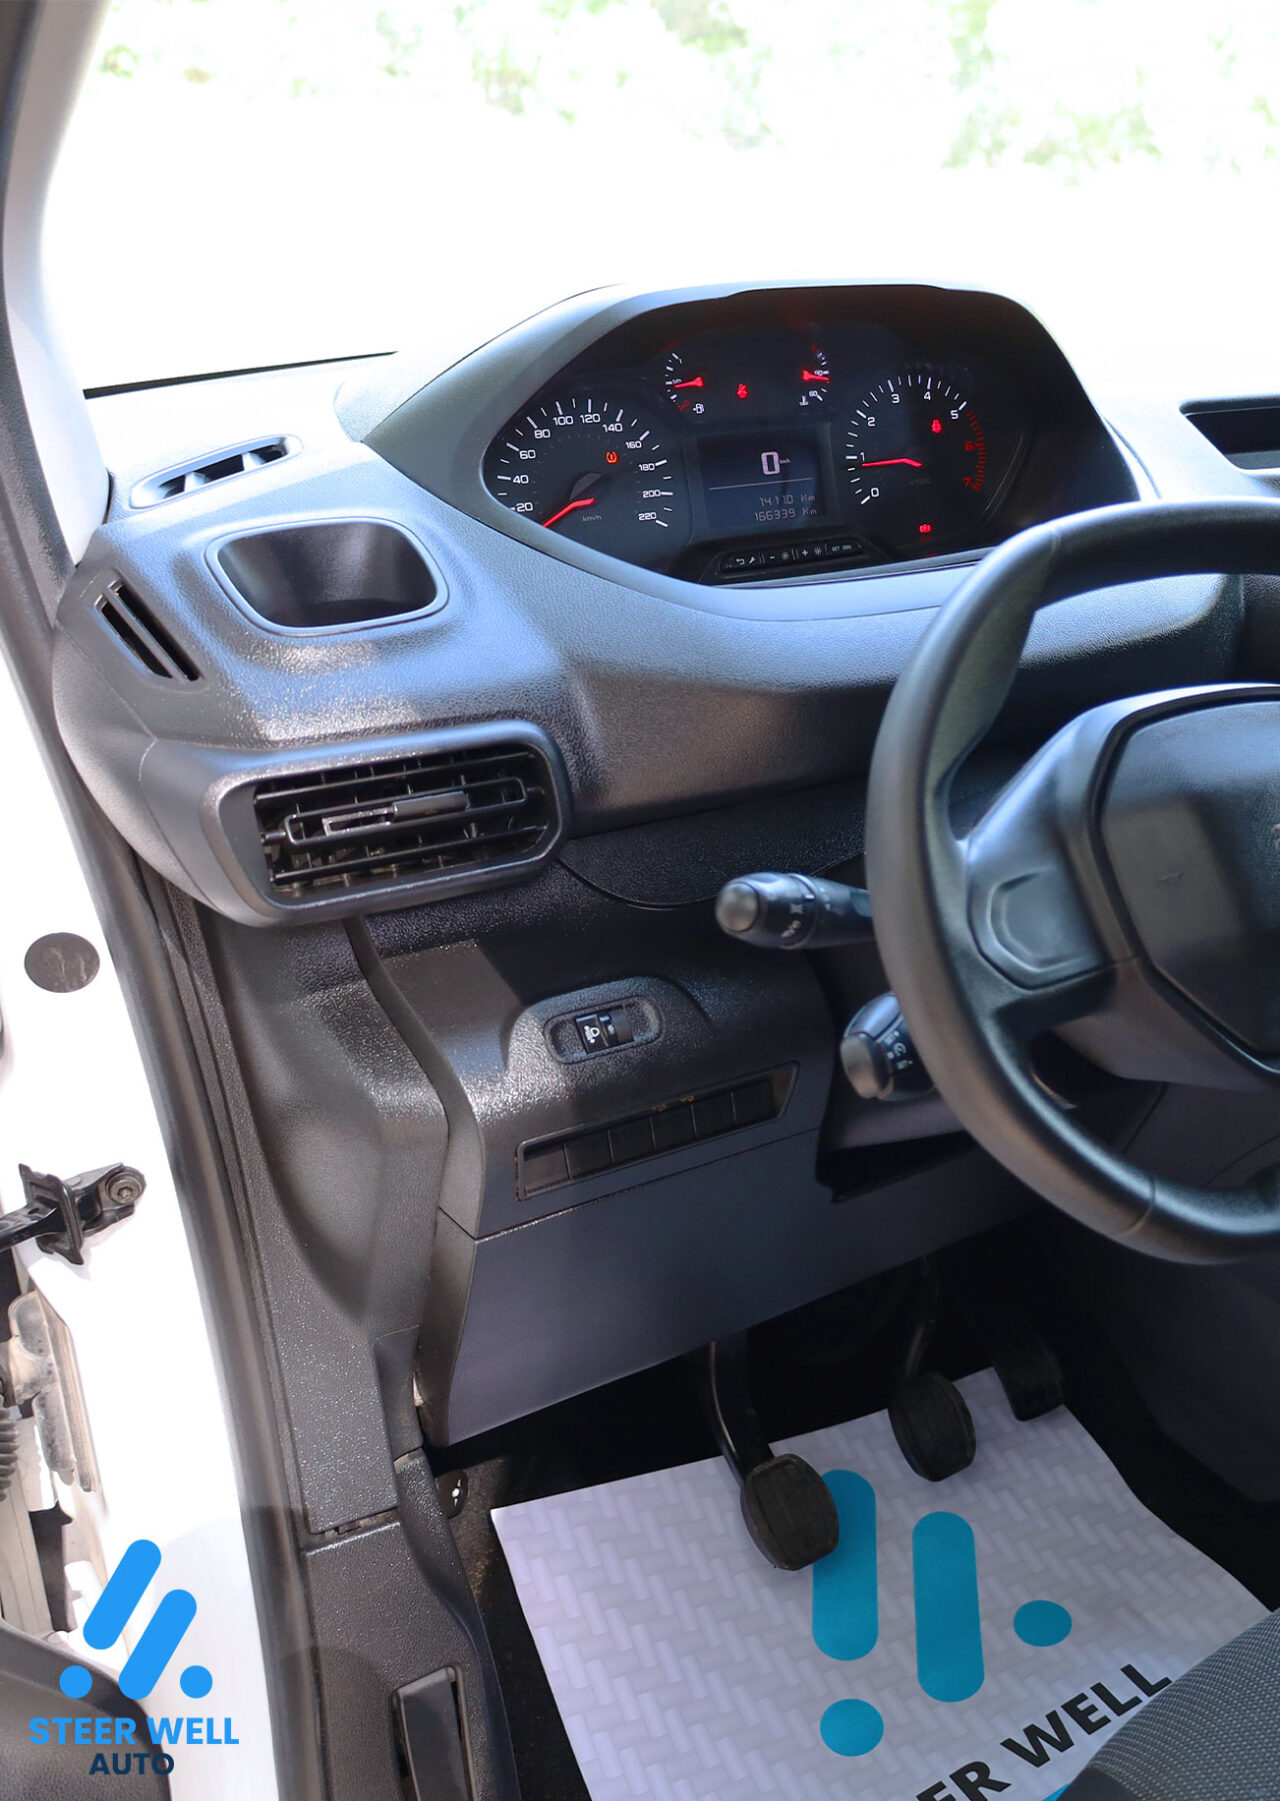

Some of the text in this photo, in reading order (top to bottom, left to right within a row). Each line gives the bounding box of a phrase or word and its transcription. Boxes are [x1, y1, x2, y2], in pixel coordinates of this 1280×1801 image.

[891, 393, 900, 404] 3
[923, 390, 931, 401] 4
[553, 415, 574, 425] 100
[580, 413, 601, 423] 120
[950, 410, 958, 420] 5
[867, 416, 876, 427] 2
[602, 423, 623, 433] 140
[534, 429, 551, 439] 80
[625, 440, 642, 449] 160
[519, 450, 536, 460] 60
[859, 452, 865, 461] 1
[638, 462, 655, 471] 180
[761, 451, 780, 475] 0
[512, 474, 529, 484] 40
[962, 477, 971, 487] 7
[642, 489, 661, 498] 200
[870, 487, 879, 497] 0
[516, 502, 533, 512] 20
[638, 512, 657, 521] 220
[754, 508, 796, 521] 166339
[999, 1663, 1173, 1769] WELL
